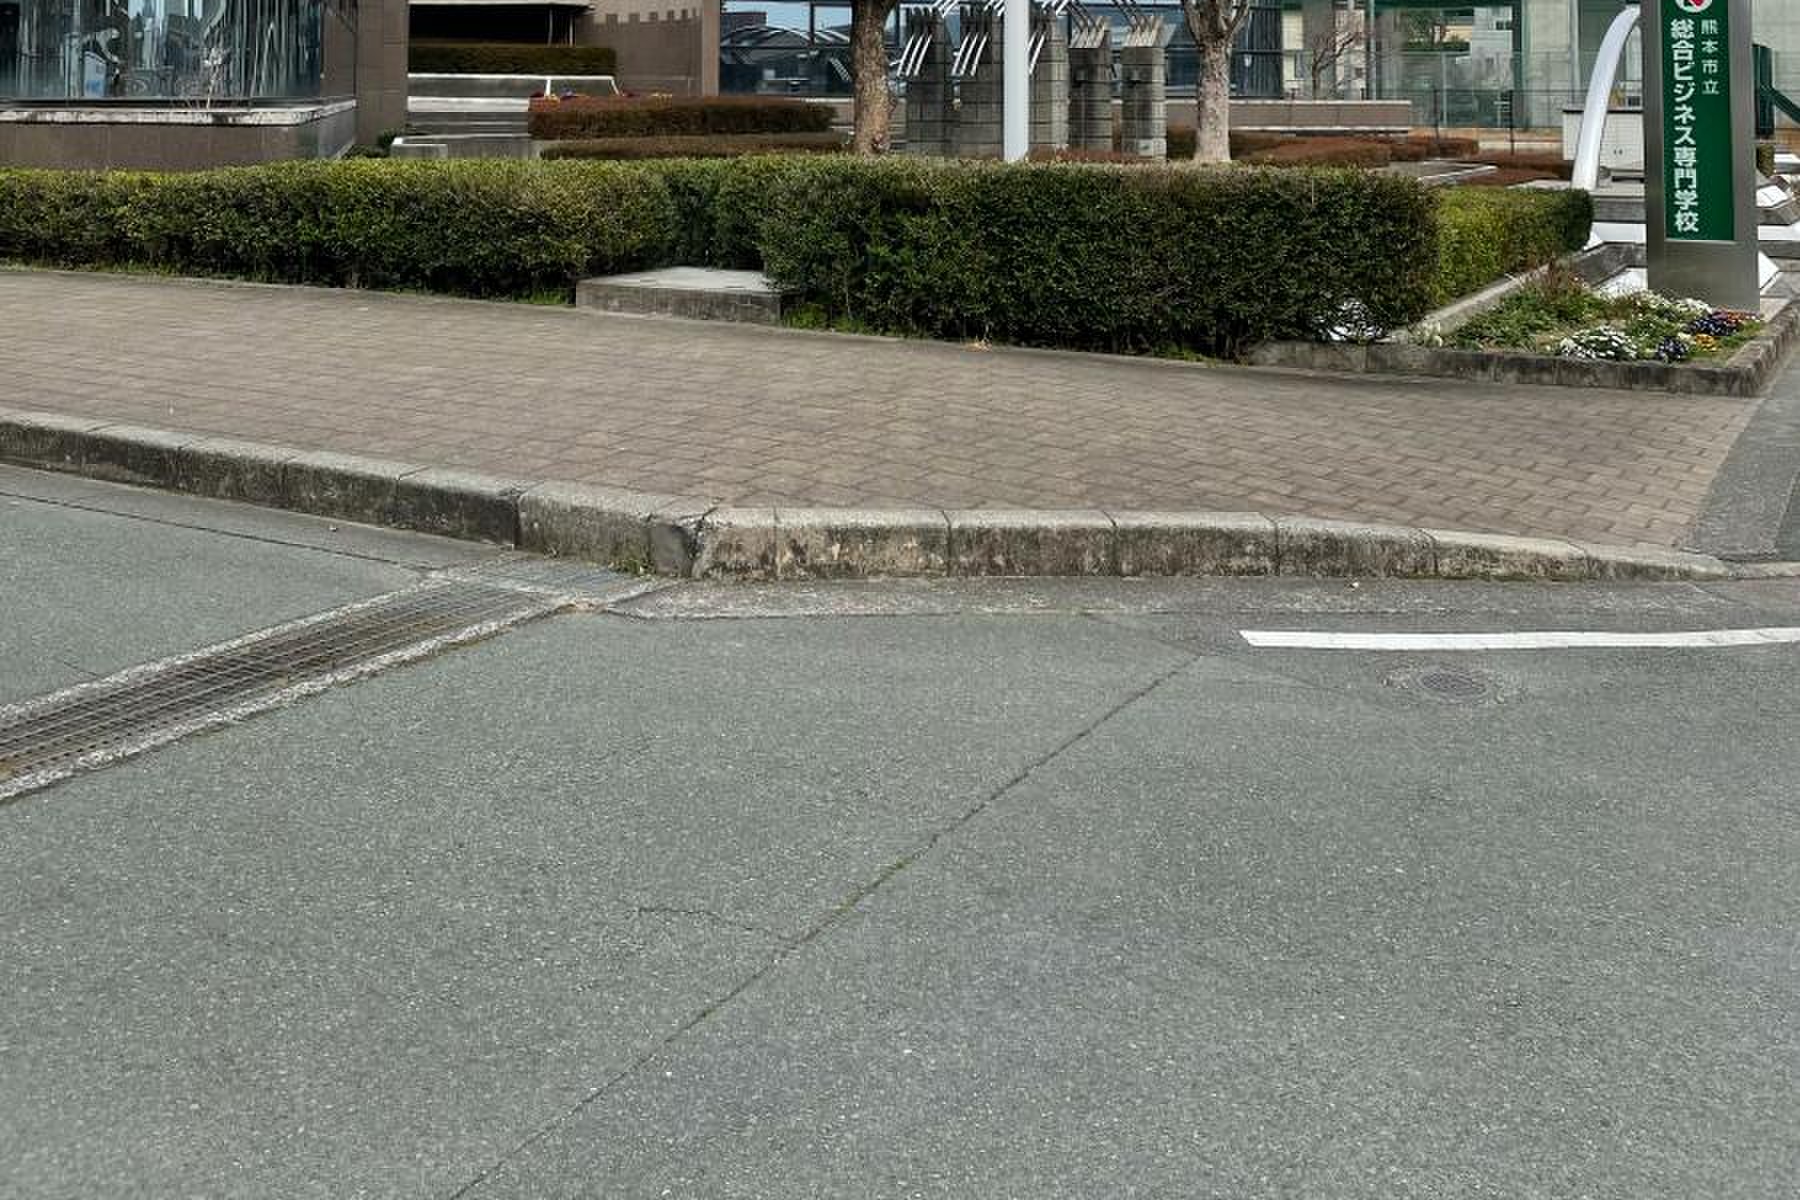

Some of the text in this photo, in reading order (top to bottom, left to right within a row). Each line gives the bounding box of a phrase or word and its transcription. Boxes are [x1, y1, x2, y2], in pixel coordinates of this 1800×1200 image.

[1670, 18, 1699, 232] 総合ビジネス専門学校
[1701, 19, 1719, 95] 熊本市立
